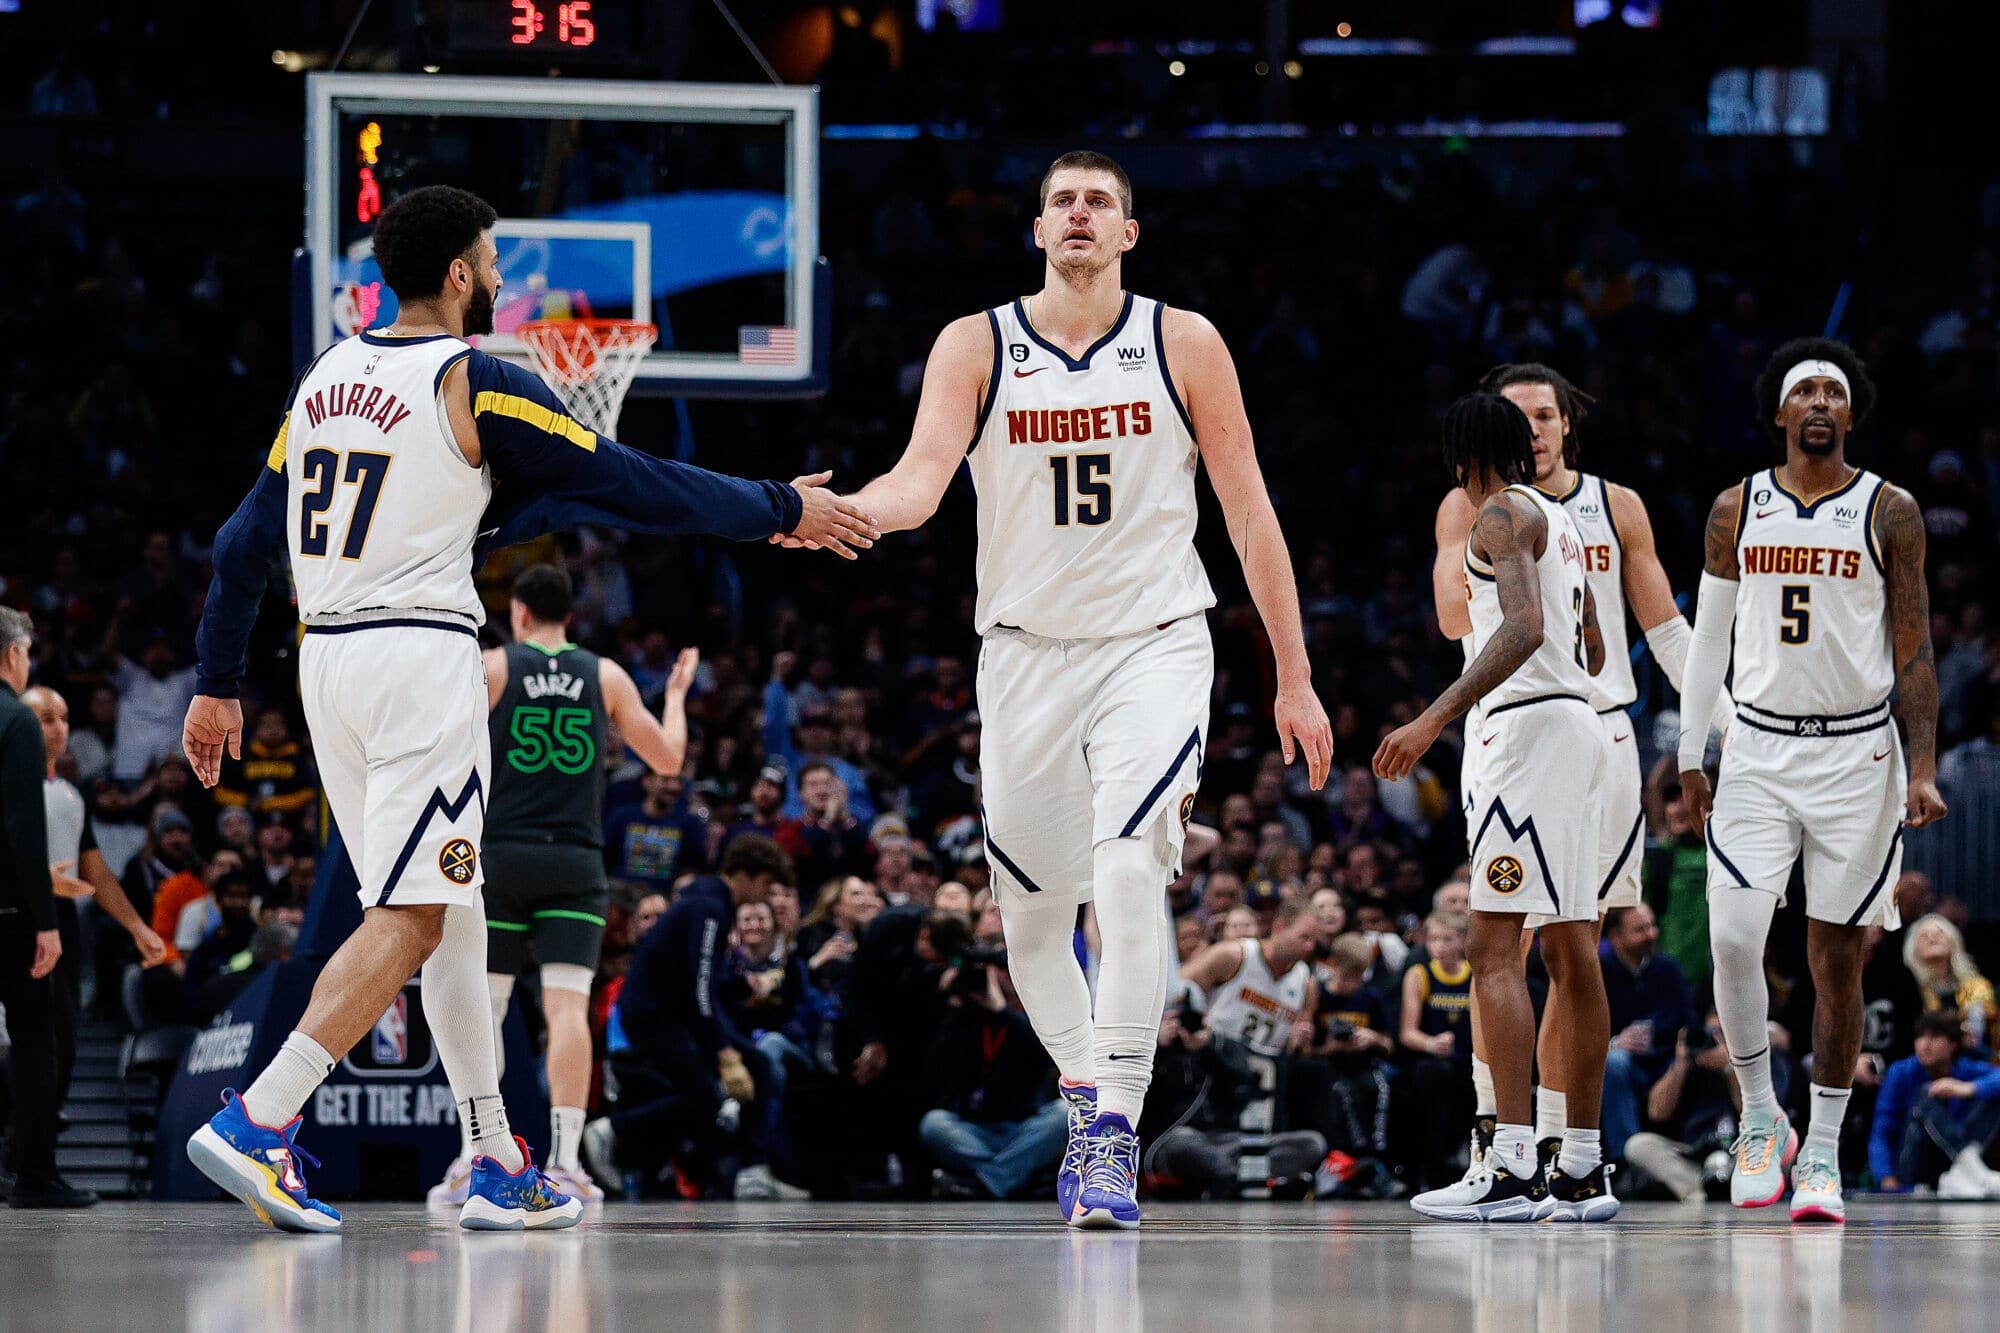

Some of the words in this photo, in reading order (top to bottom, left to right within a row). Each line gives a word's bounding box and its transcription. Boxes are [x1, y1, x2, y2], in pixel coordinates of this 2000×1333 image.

[512, 0, 594, 46] 3:15
[1117, 347, 1145, 360] WU
[1118, 360, 1147, 368] Western
[305, 382, 411, 434] MURRAY
[1006, 401, 1152, 445] NUGGETS
[300, 445, 395, 563] 27
[1048, 452, 1113, 529] 15
[1835, 507, 1858, 519] WU
[1743, 545, 1861, 580] NUGGETS
[1779, 584, 1811, 645] 5
[507, 706, 595, 774] 55
[315, 1084, 361, 1126] GET
[365, 1084, 413, 1126] THE
